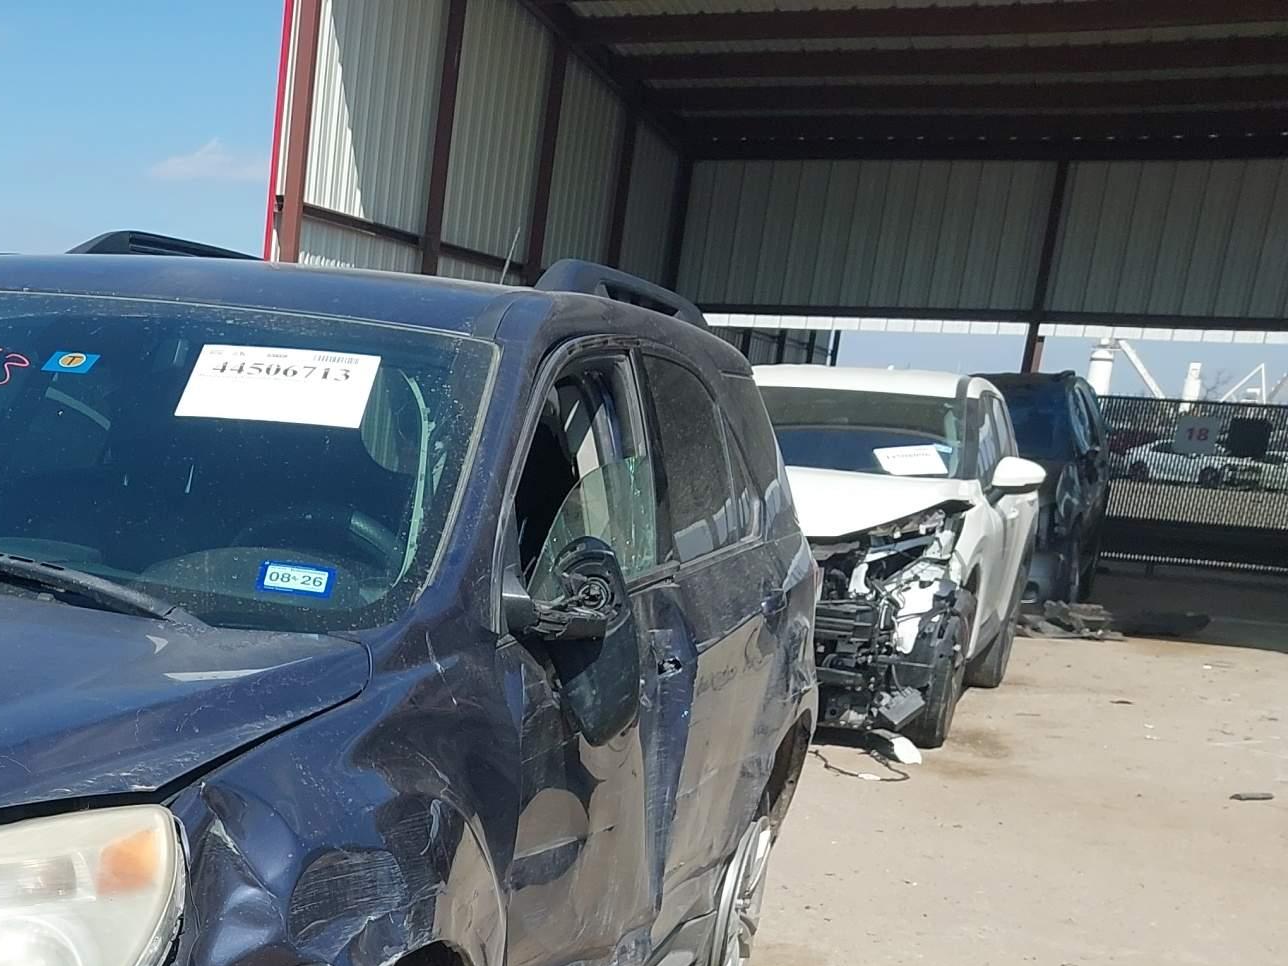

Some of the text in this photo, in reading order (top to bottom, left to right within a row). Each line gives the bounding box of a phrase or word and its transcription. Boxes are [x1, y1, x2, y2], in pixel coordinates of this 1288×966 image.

[212, 361, 351, 382] 44506713
[1186, 427, 1209, 441] 18
[269, 571, 292, 584] 08
[300, 575, 323, 587] 26
